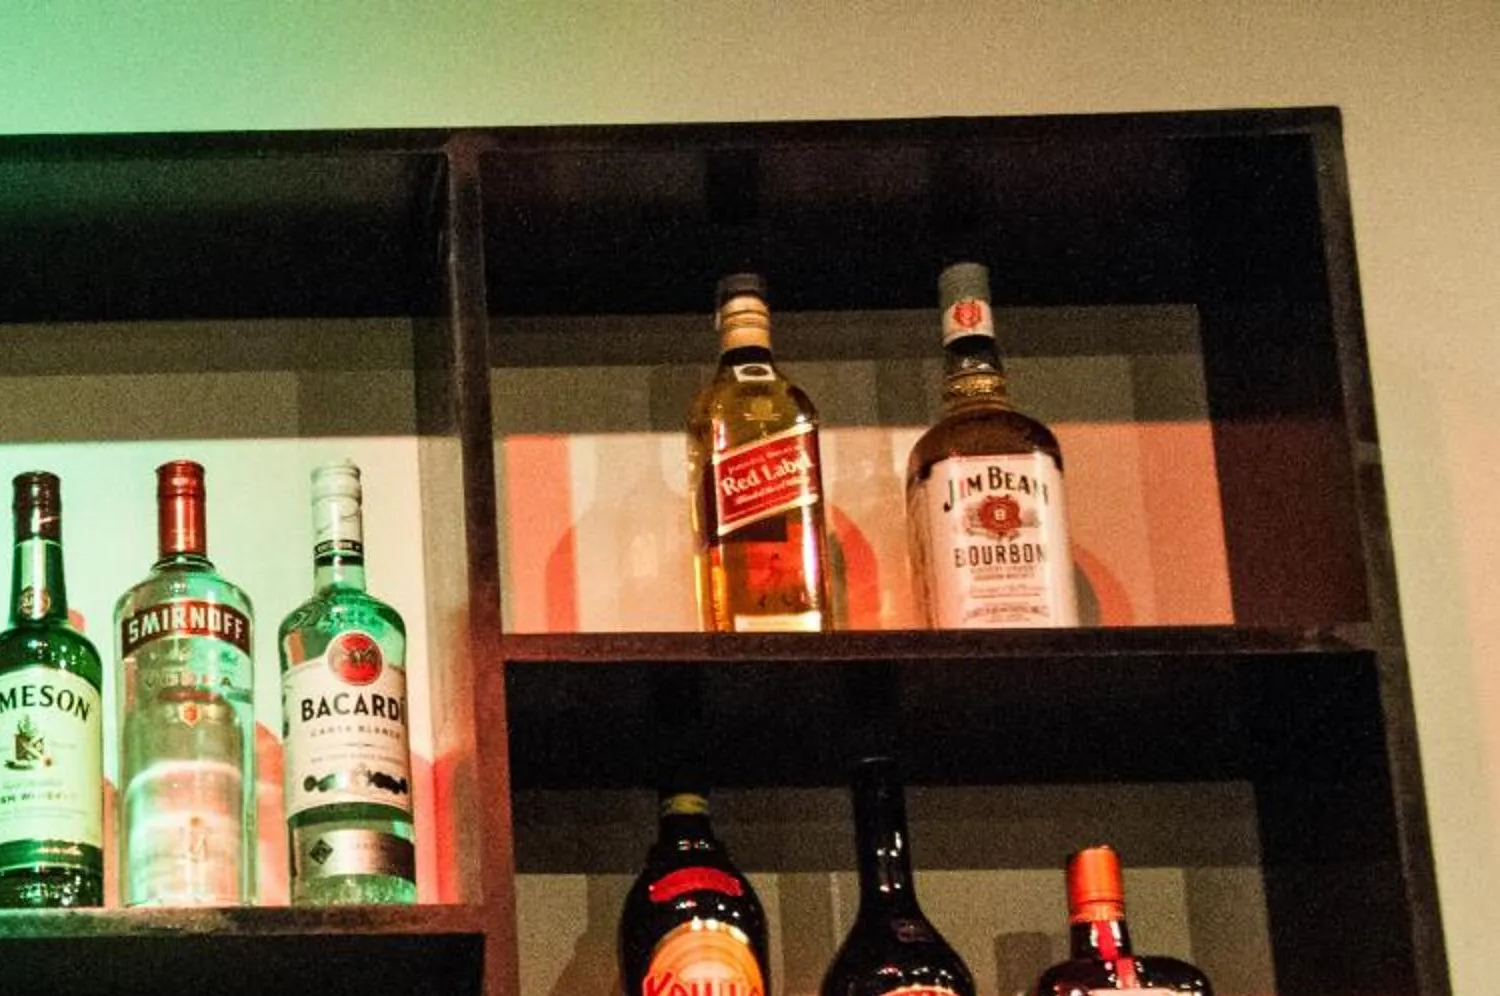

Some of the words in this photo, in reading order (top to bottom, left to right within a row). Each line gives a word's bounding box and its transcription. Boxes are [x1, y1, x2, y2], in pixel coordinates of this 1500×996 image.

[722, 468, 762, 497] Red
[944, 472, 982, 513] JIM
[954, 543, 1046, 569] BOURBON
[127, 605, 245, 644] SMIRNOFF
